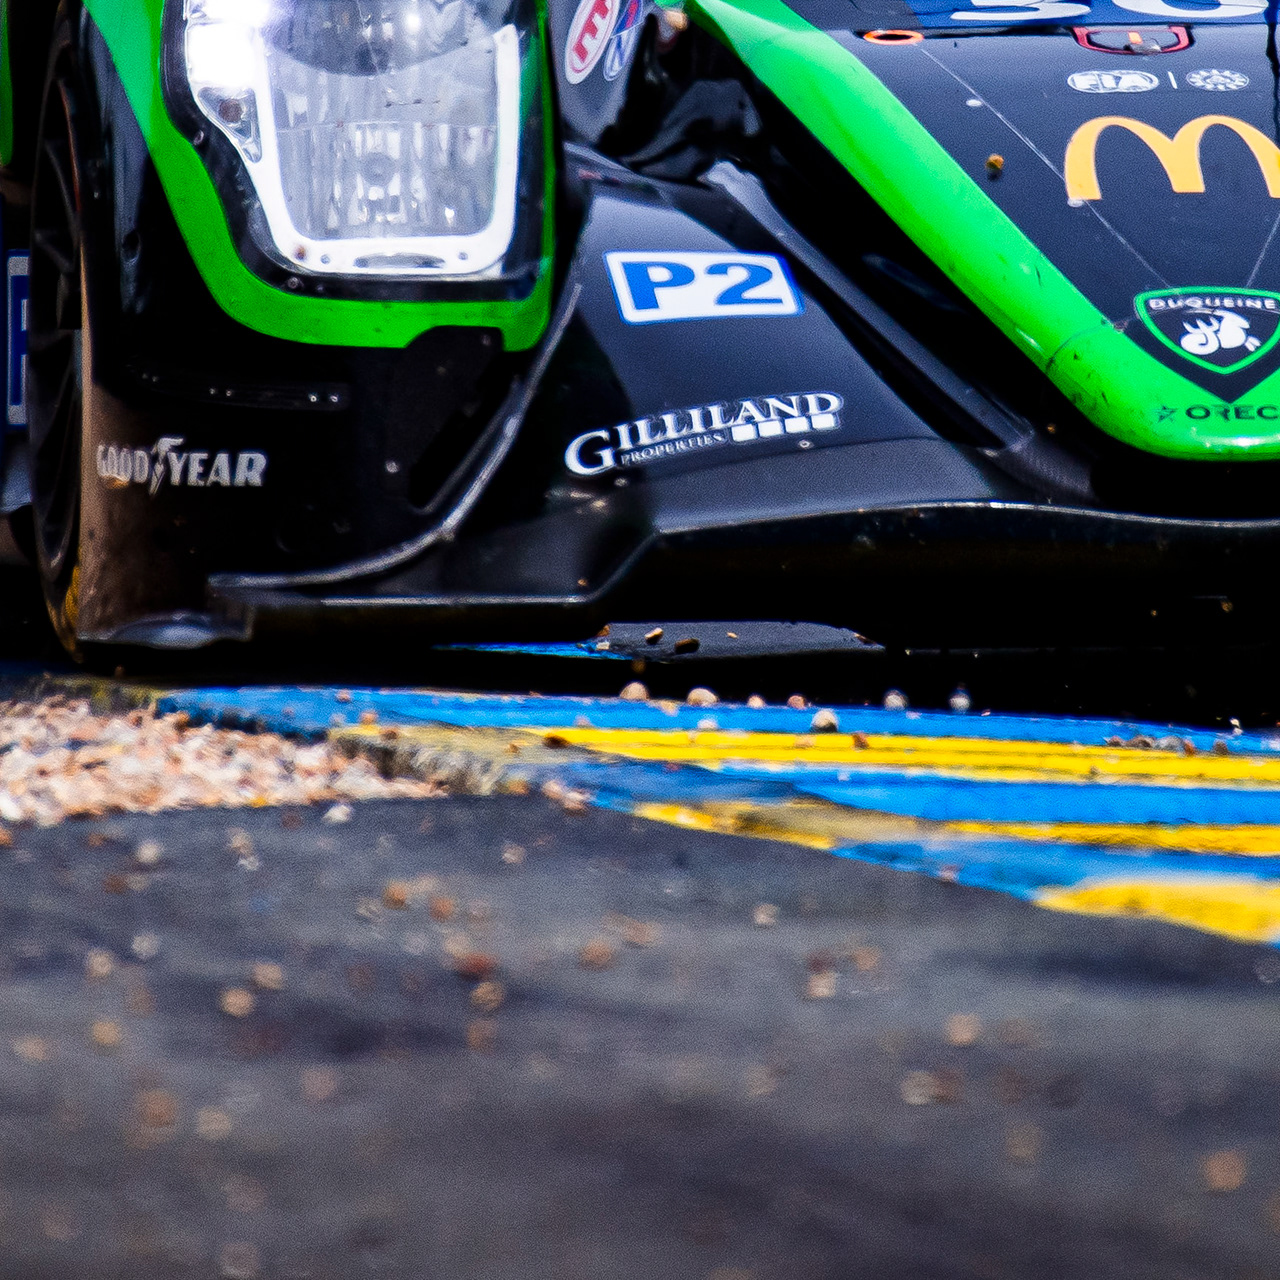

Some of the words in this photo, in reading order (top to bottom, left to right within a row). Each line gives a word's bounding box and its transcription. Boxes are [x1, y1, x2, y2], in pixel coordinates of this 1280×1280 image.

[1067, 70, 1160, 92] FIA
[622, 261, 783, 310] P2
[1148, 296, 1277, 310] DUQUEINE
[563, 392, 842, 476] GILLILAND
